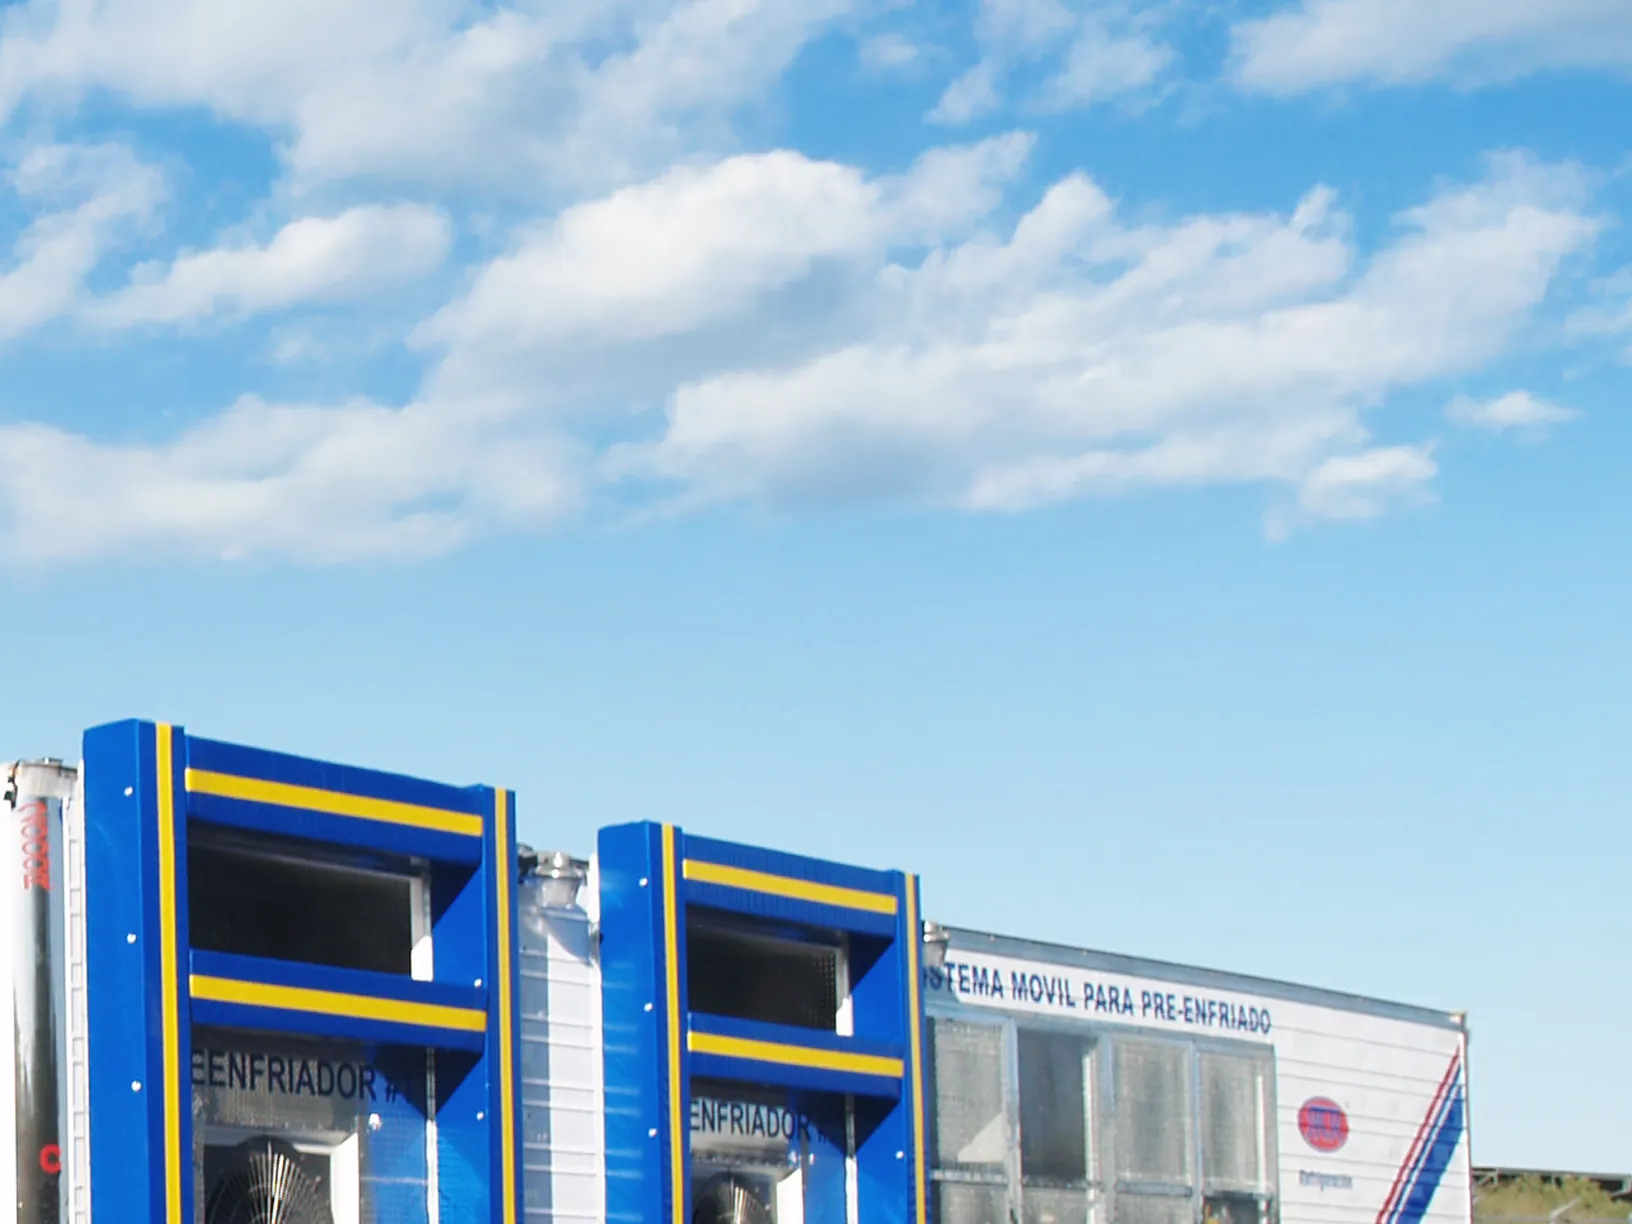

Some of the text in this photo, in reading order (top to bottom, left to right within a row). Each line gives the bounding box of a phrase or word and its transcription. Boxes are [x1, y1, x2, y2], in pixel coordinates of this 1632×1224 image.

[1010, 971, 1077, 1008] MOVIL
[1084, 982, 1135, 1016] PARA
[1141, 990, 1272, 1035] PRE-ENFRIADO
